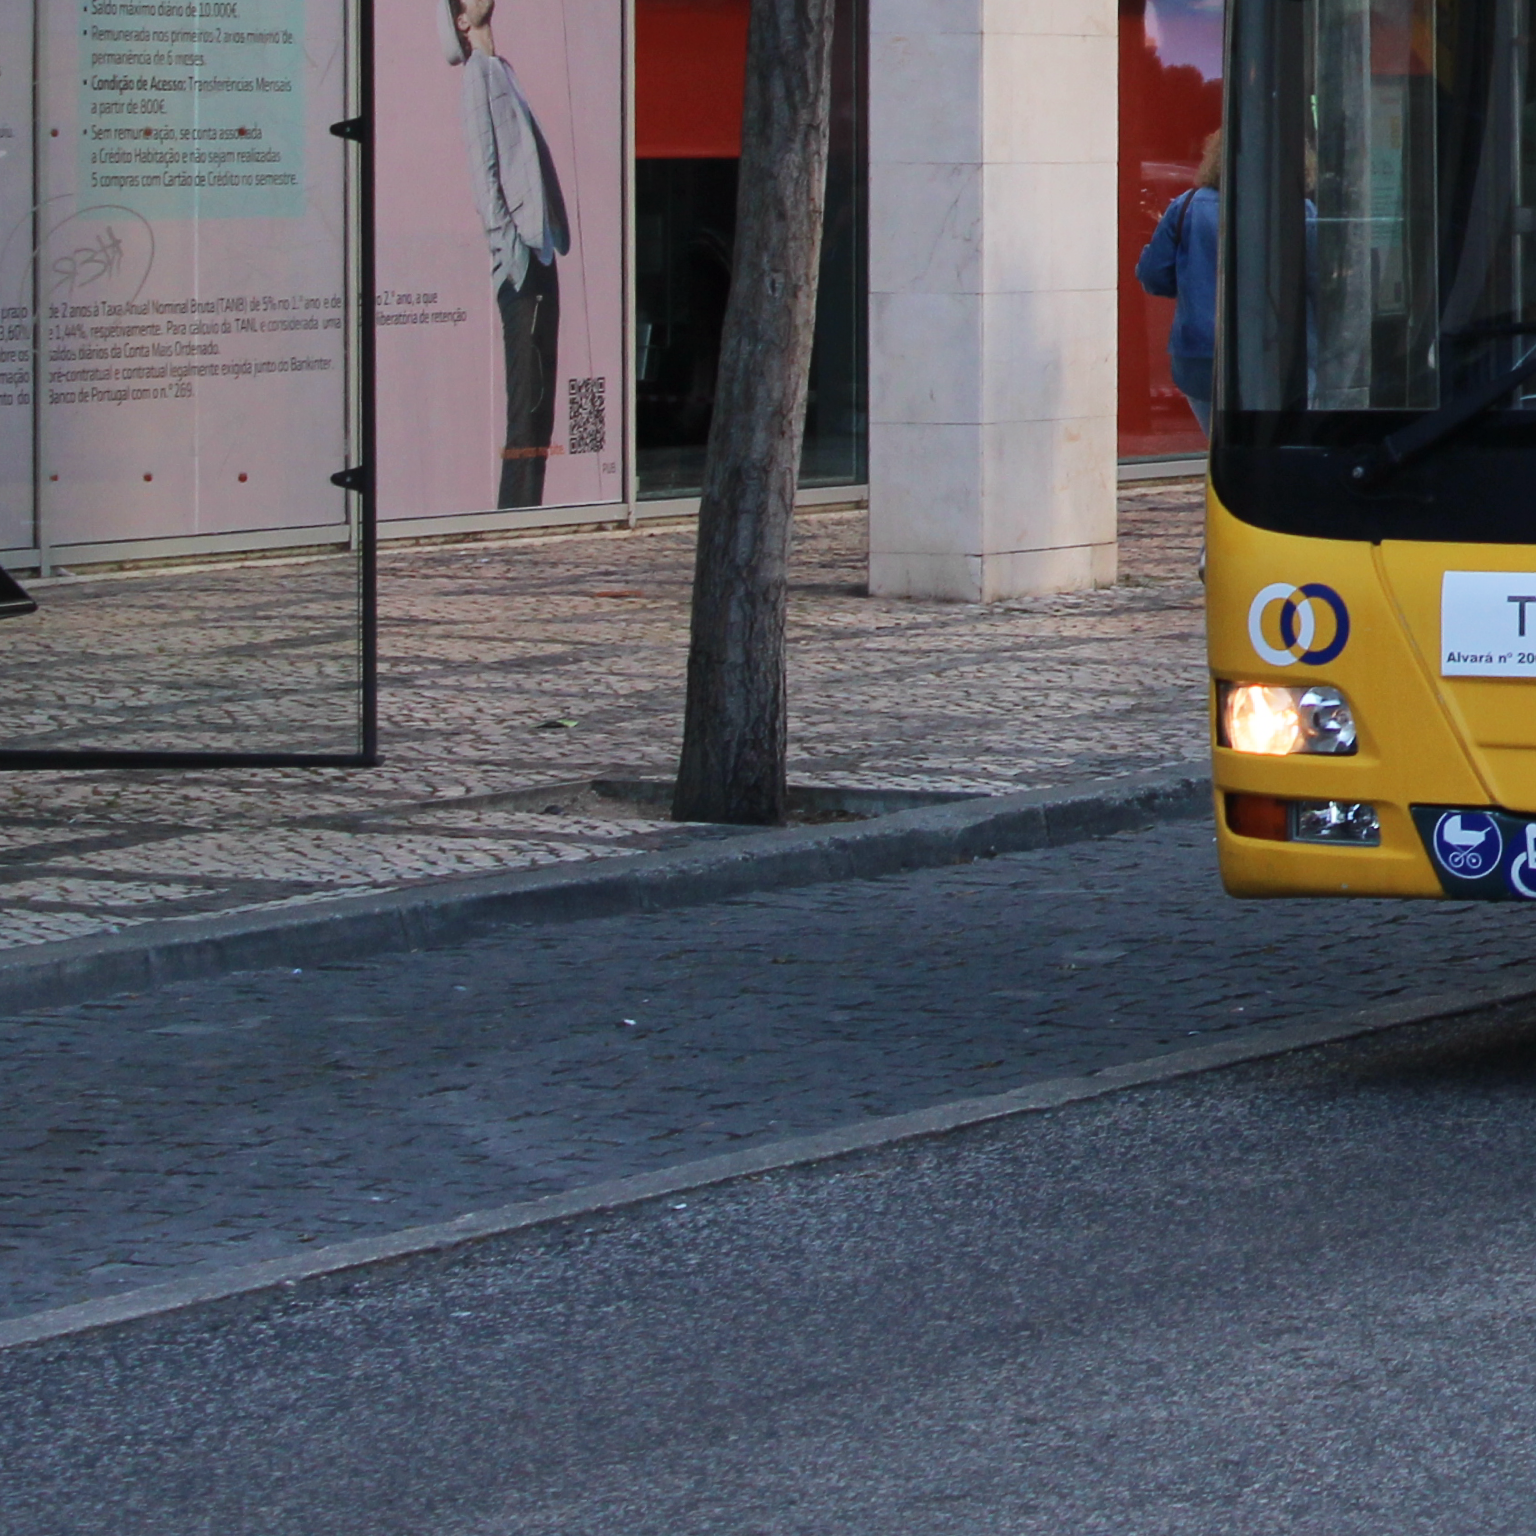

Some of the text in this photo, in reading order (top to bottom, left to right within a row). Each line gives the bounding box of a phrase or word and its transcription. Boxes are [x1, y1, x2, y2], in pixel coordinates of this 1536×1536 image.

[91, 0, 117, 15] Saldo
[185, 1, 197, 17] de
[215, 27, 223, 43] 2
[153, 50, 165, 65] de
[91, 74, 134, 95] Condição
[136, 75, 148, 91] de
[91, 102, 97, 114] a
[127, 98, 138, 114] de
[91, 124, 112, 140] Sem
[91, 151, 97, 164] a
[91, 171, 98, 187] 5
[141, 174, 161, 187] com
[331, 294, 342, 308] de
[1447, 650, 1493, 665] Alvará
